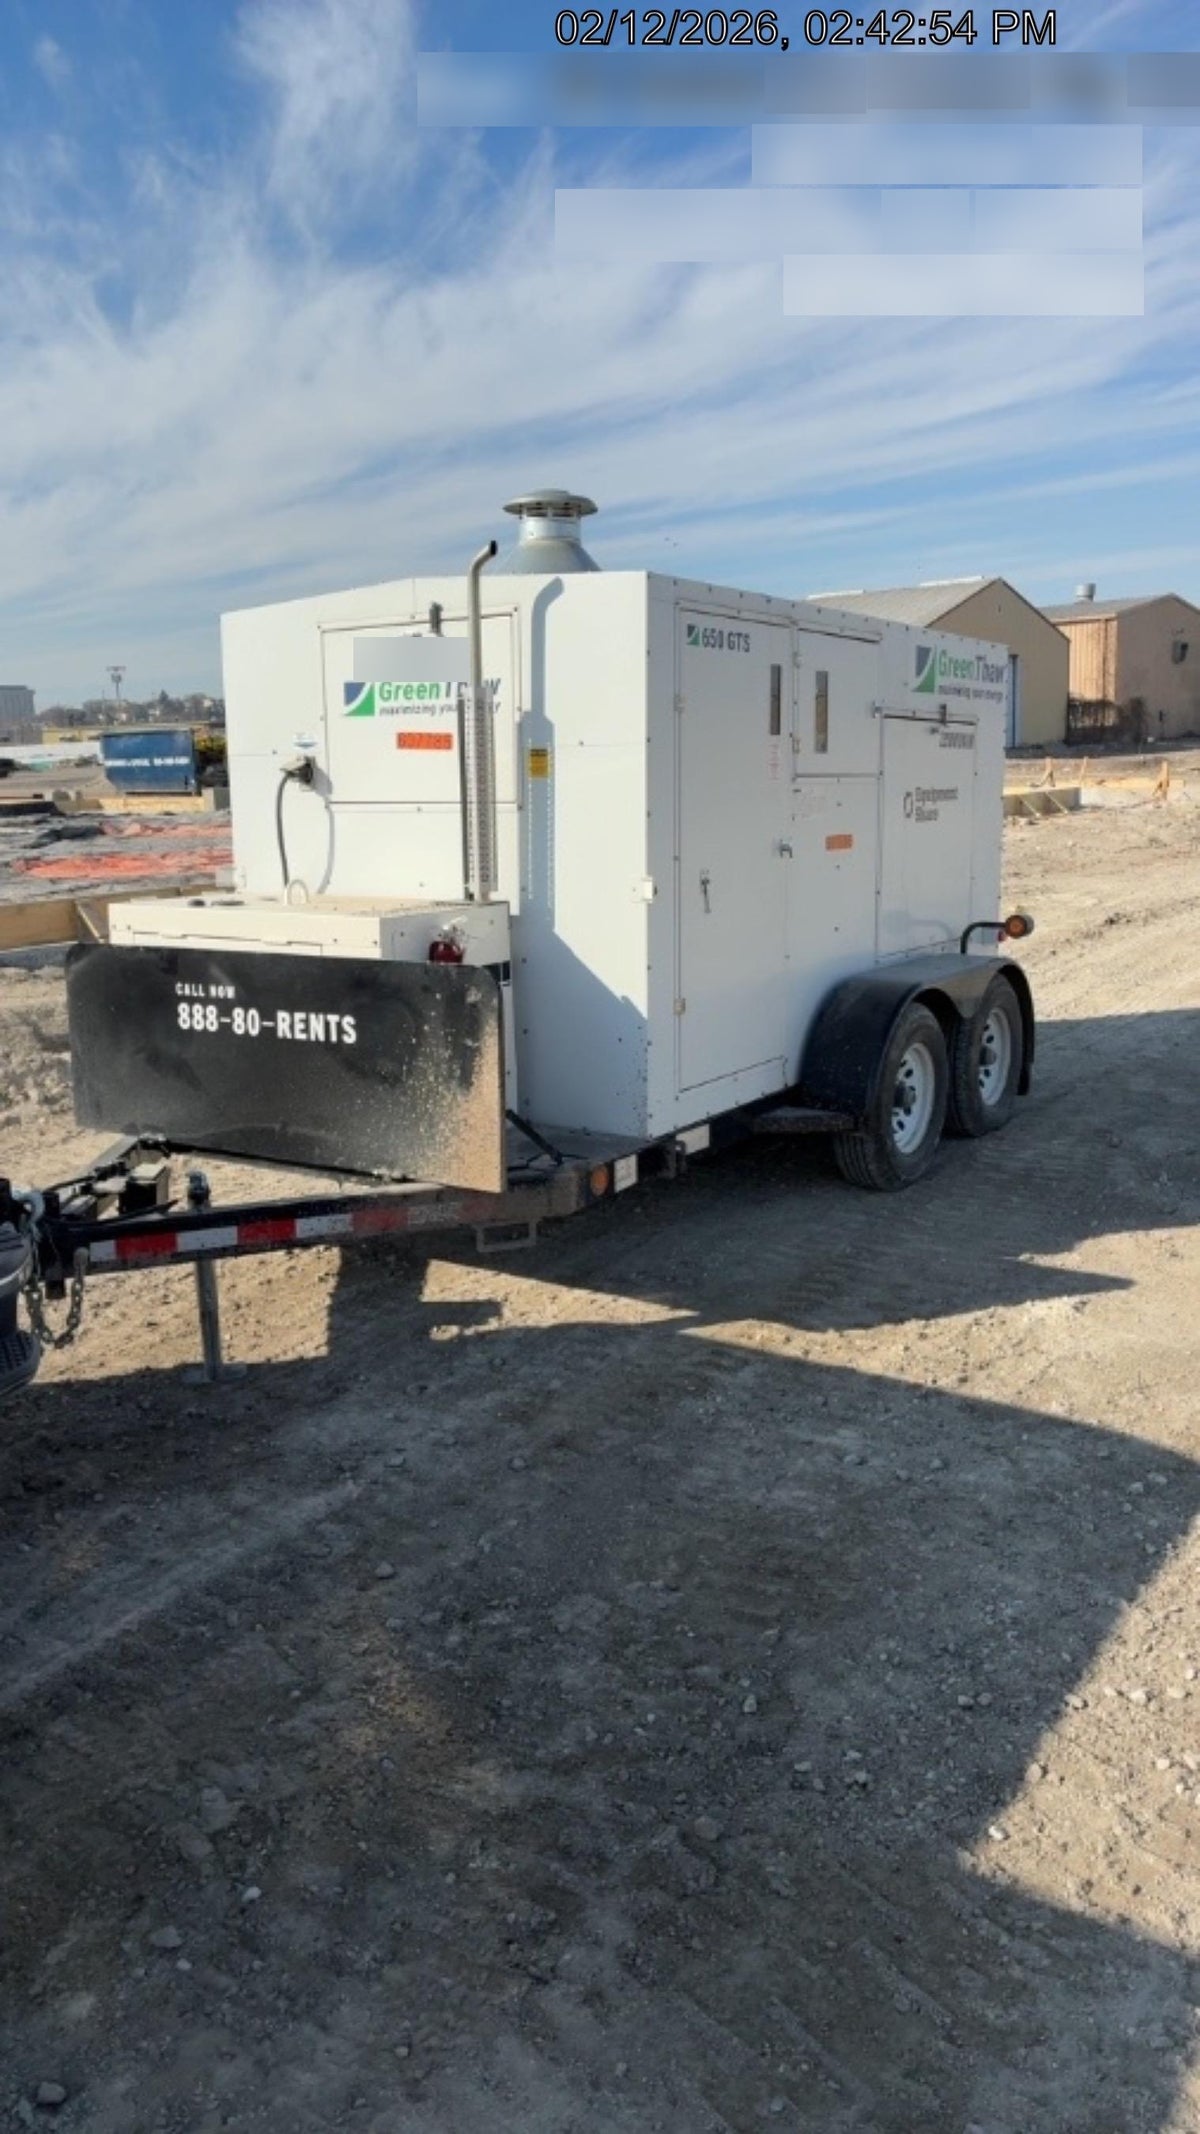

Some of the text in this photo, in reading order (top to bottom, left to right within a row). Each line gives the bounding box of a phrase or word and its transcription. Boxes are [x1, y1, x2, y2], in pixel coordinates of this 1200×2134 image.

[702, 627, 751, 653] 650 GTS
[175, 982, 236, 999] CALL NOW
[177, 1002, 357, 1045] 888-80-RENTS
